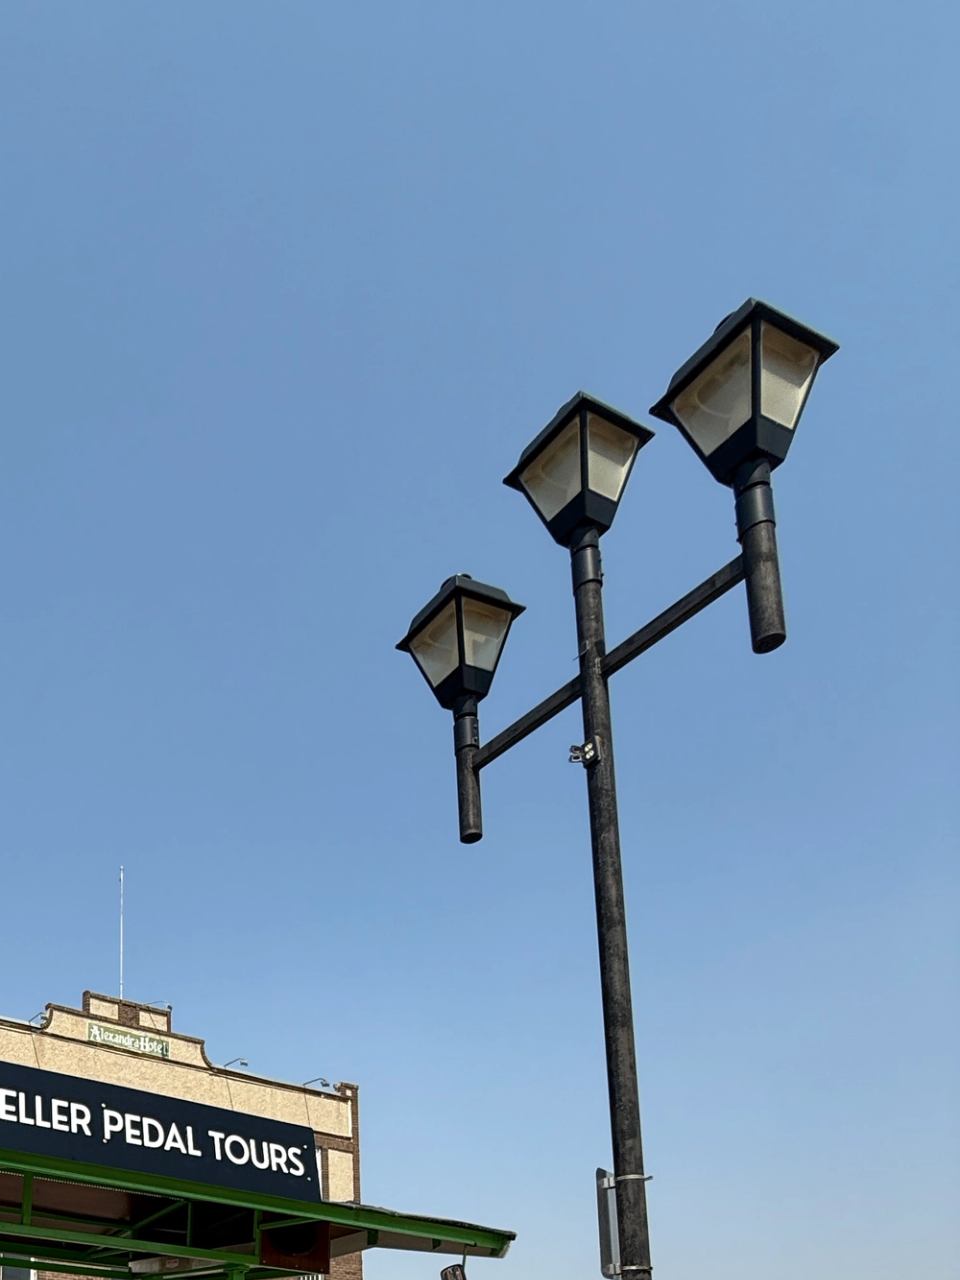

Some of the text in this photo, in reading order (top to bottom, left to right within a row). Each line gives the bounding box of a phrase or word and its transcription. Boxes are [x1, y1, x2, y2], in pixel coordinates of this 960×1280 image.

[89, 1024, 167, 1055] Alexandra Hotel
[103, 1109, 202, 1158] PEDAL
[208, 1130, 306, 1178] TOURS
